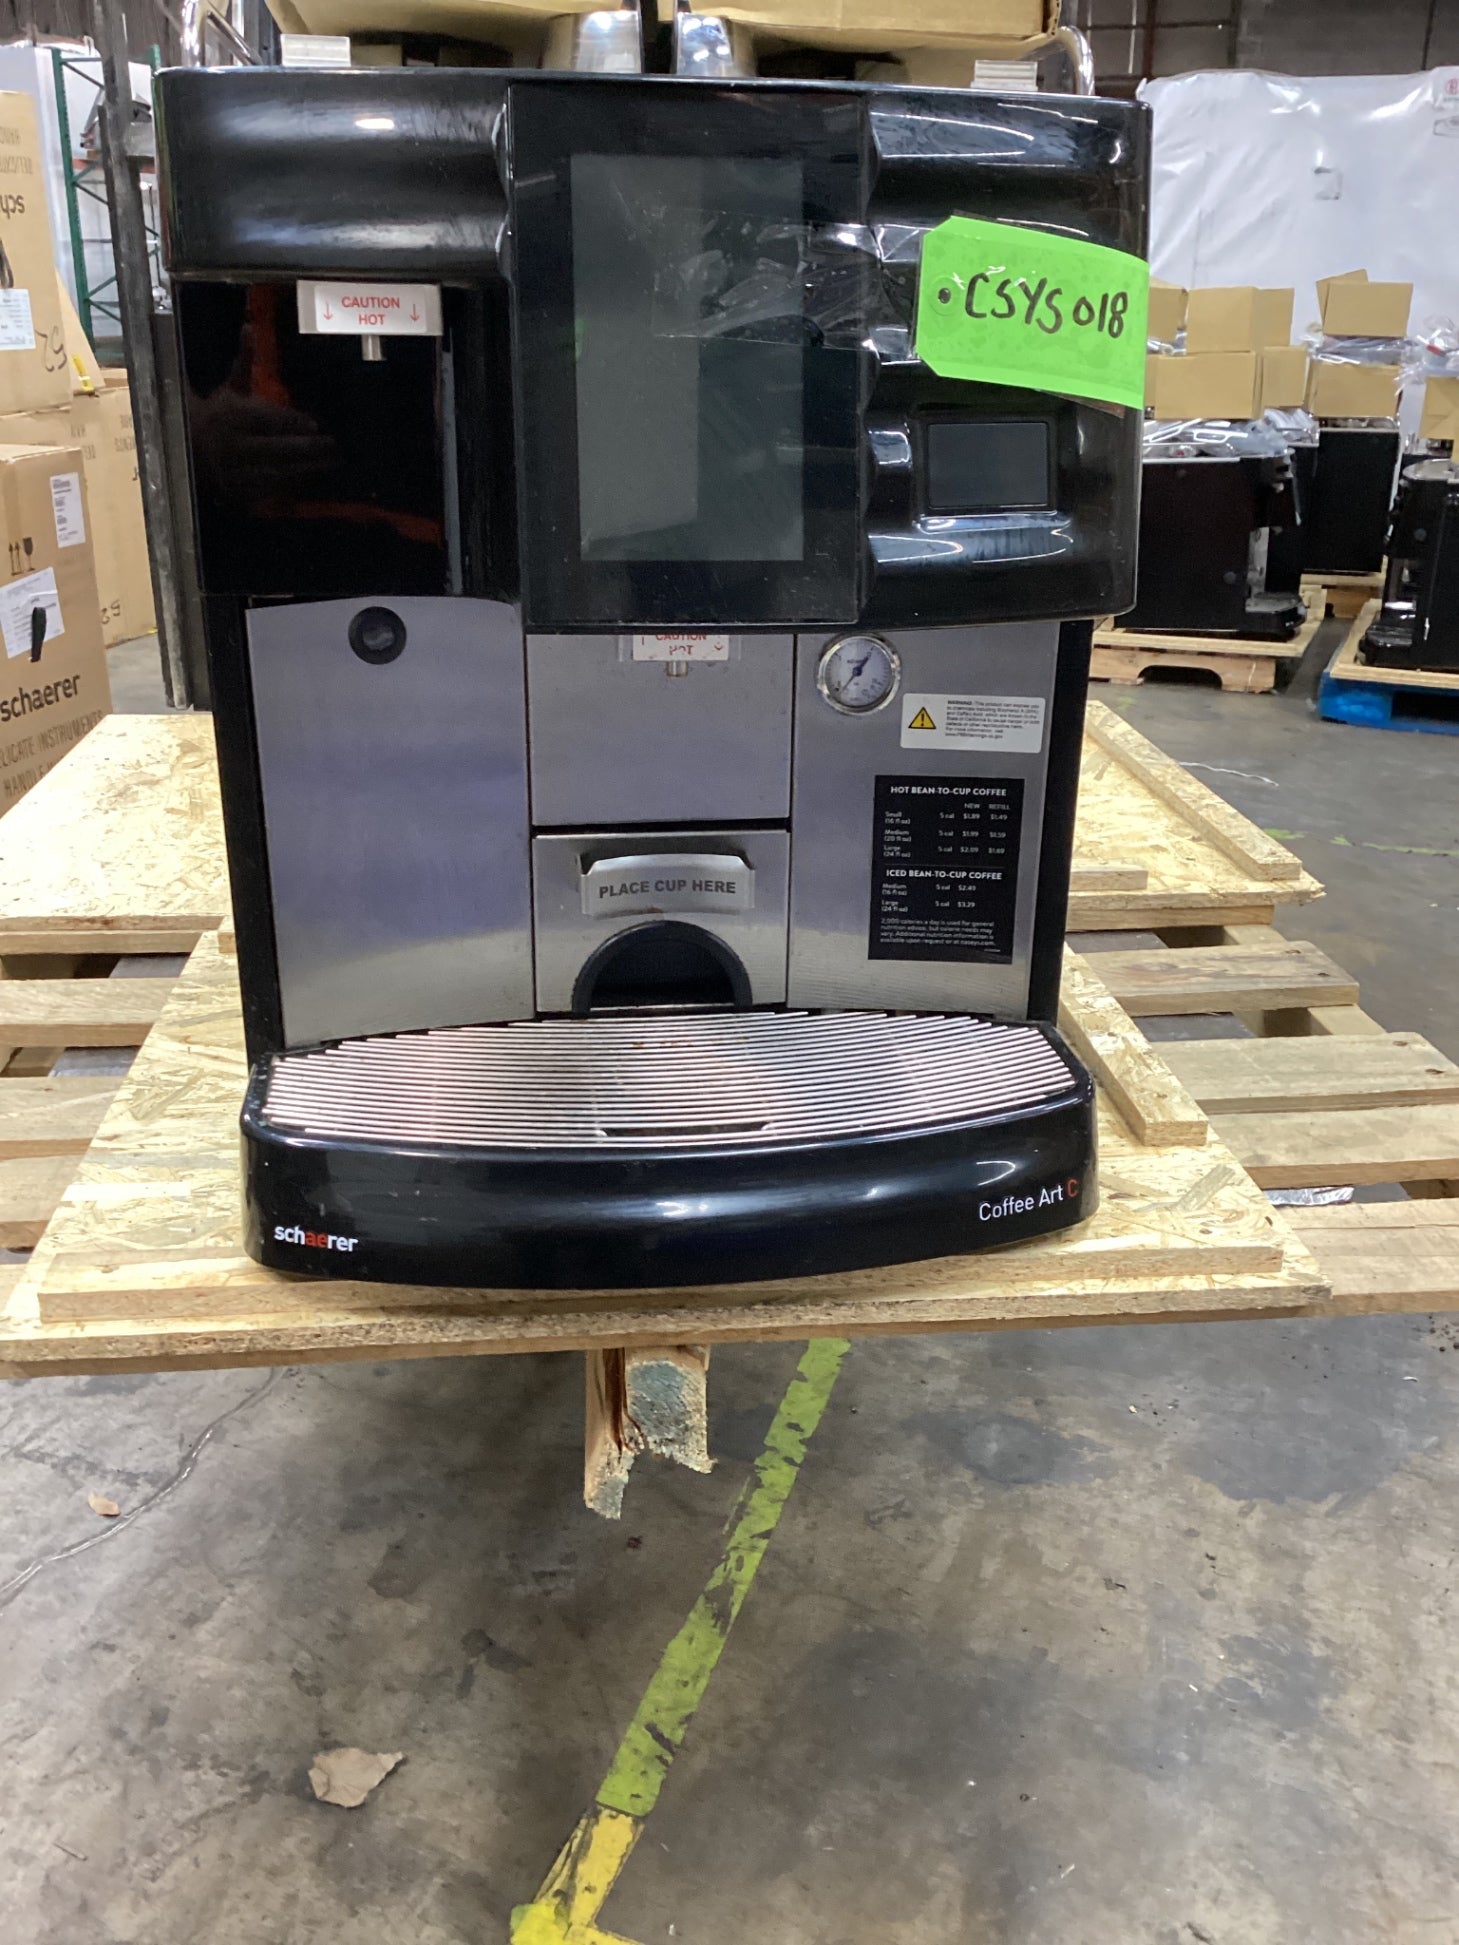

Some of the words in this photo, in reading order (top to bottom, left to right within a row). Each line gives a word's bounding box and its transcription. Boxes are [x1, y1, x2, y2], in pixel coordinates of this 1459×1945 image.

[341, 296, 401, 309] CAUTION
[358, 314, 386, 326] HOT
[0, 674, 81, 723] schaerer
[890, 786, 909, 795] HOT
[911, 786, 972, 796] BEAN-TO-CUP
[972, 788, 1007, 796] COFFEE
[886, 869, 907, 877] ICED
[908, 869, 967, 878] BEAN-TO-CUP
[968, 871, 1003, 880] COFFEE
[599, 880, 650, 899] PLACE
[654, 879, 687, 893] CUP
[691, 879, 737, 894] HERE
[979, 1196, 1035, 1221] Coffee
[1038, 1184, 1064, 1208] Art
[1066, 1178, 1078, 1198] C
[273, 1224, 359, 1252] schaerer
